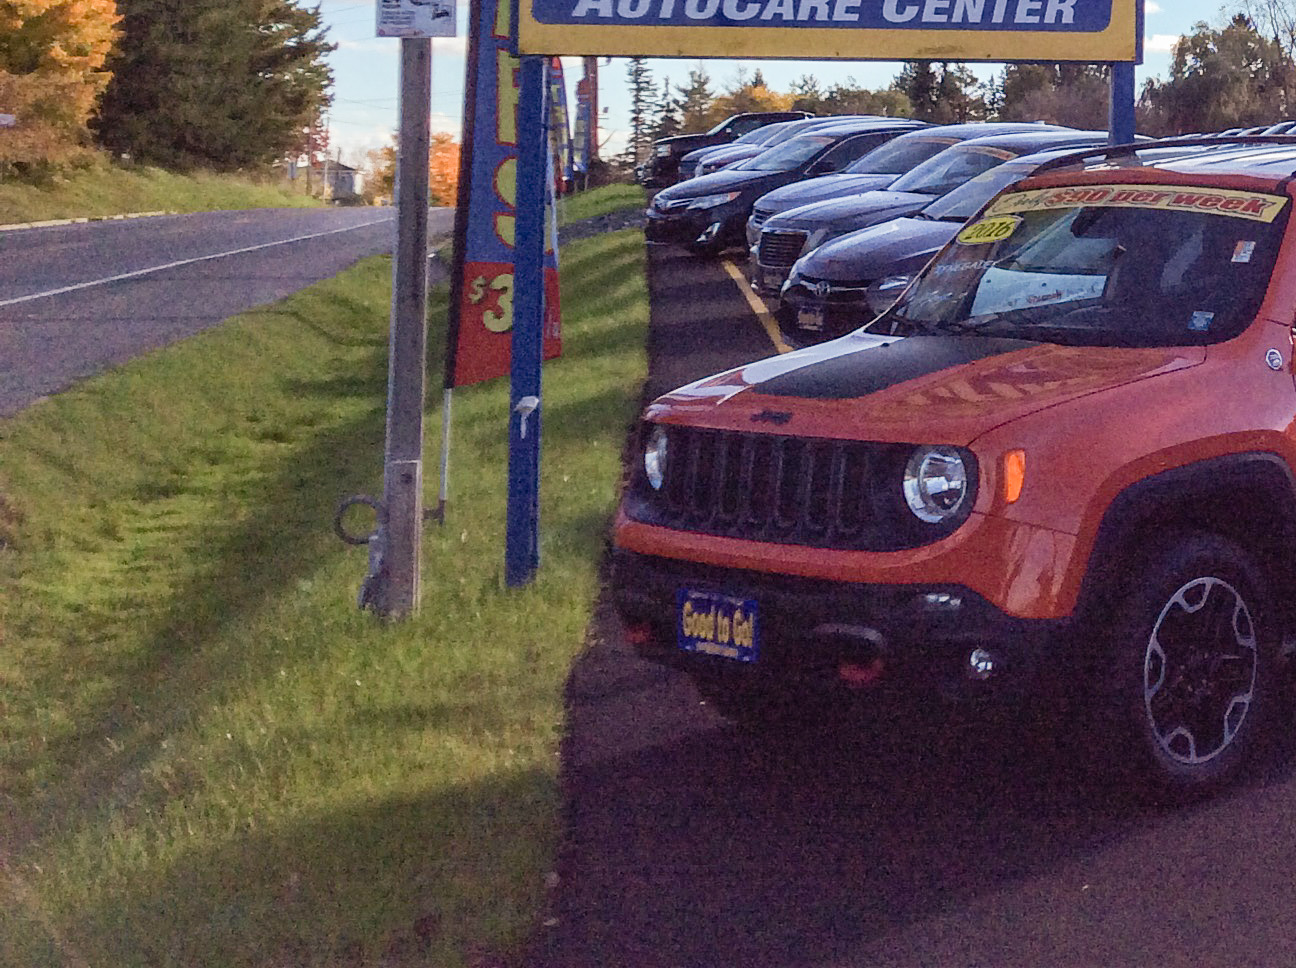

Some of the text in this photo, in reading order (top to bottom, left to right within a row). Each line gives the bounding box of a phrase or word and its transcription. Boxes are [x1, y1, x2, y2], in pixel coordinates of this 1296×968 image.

[1109, 188, 1171, 206] per
[1169, 190, 1275, 217] week
[963, 220, 1014, 241] 2016
[717, 610, 730, 644] to
